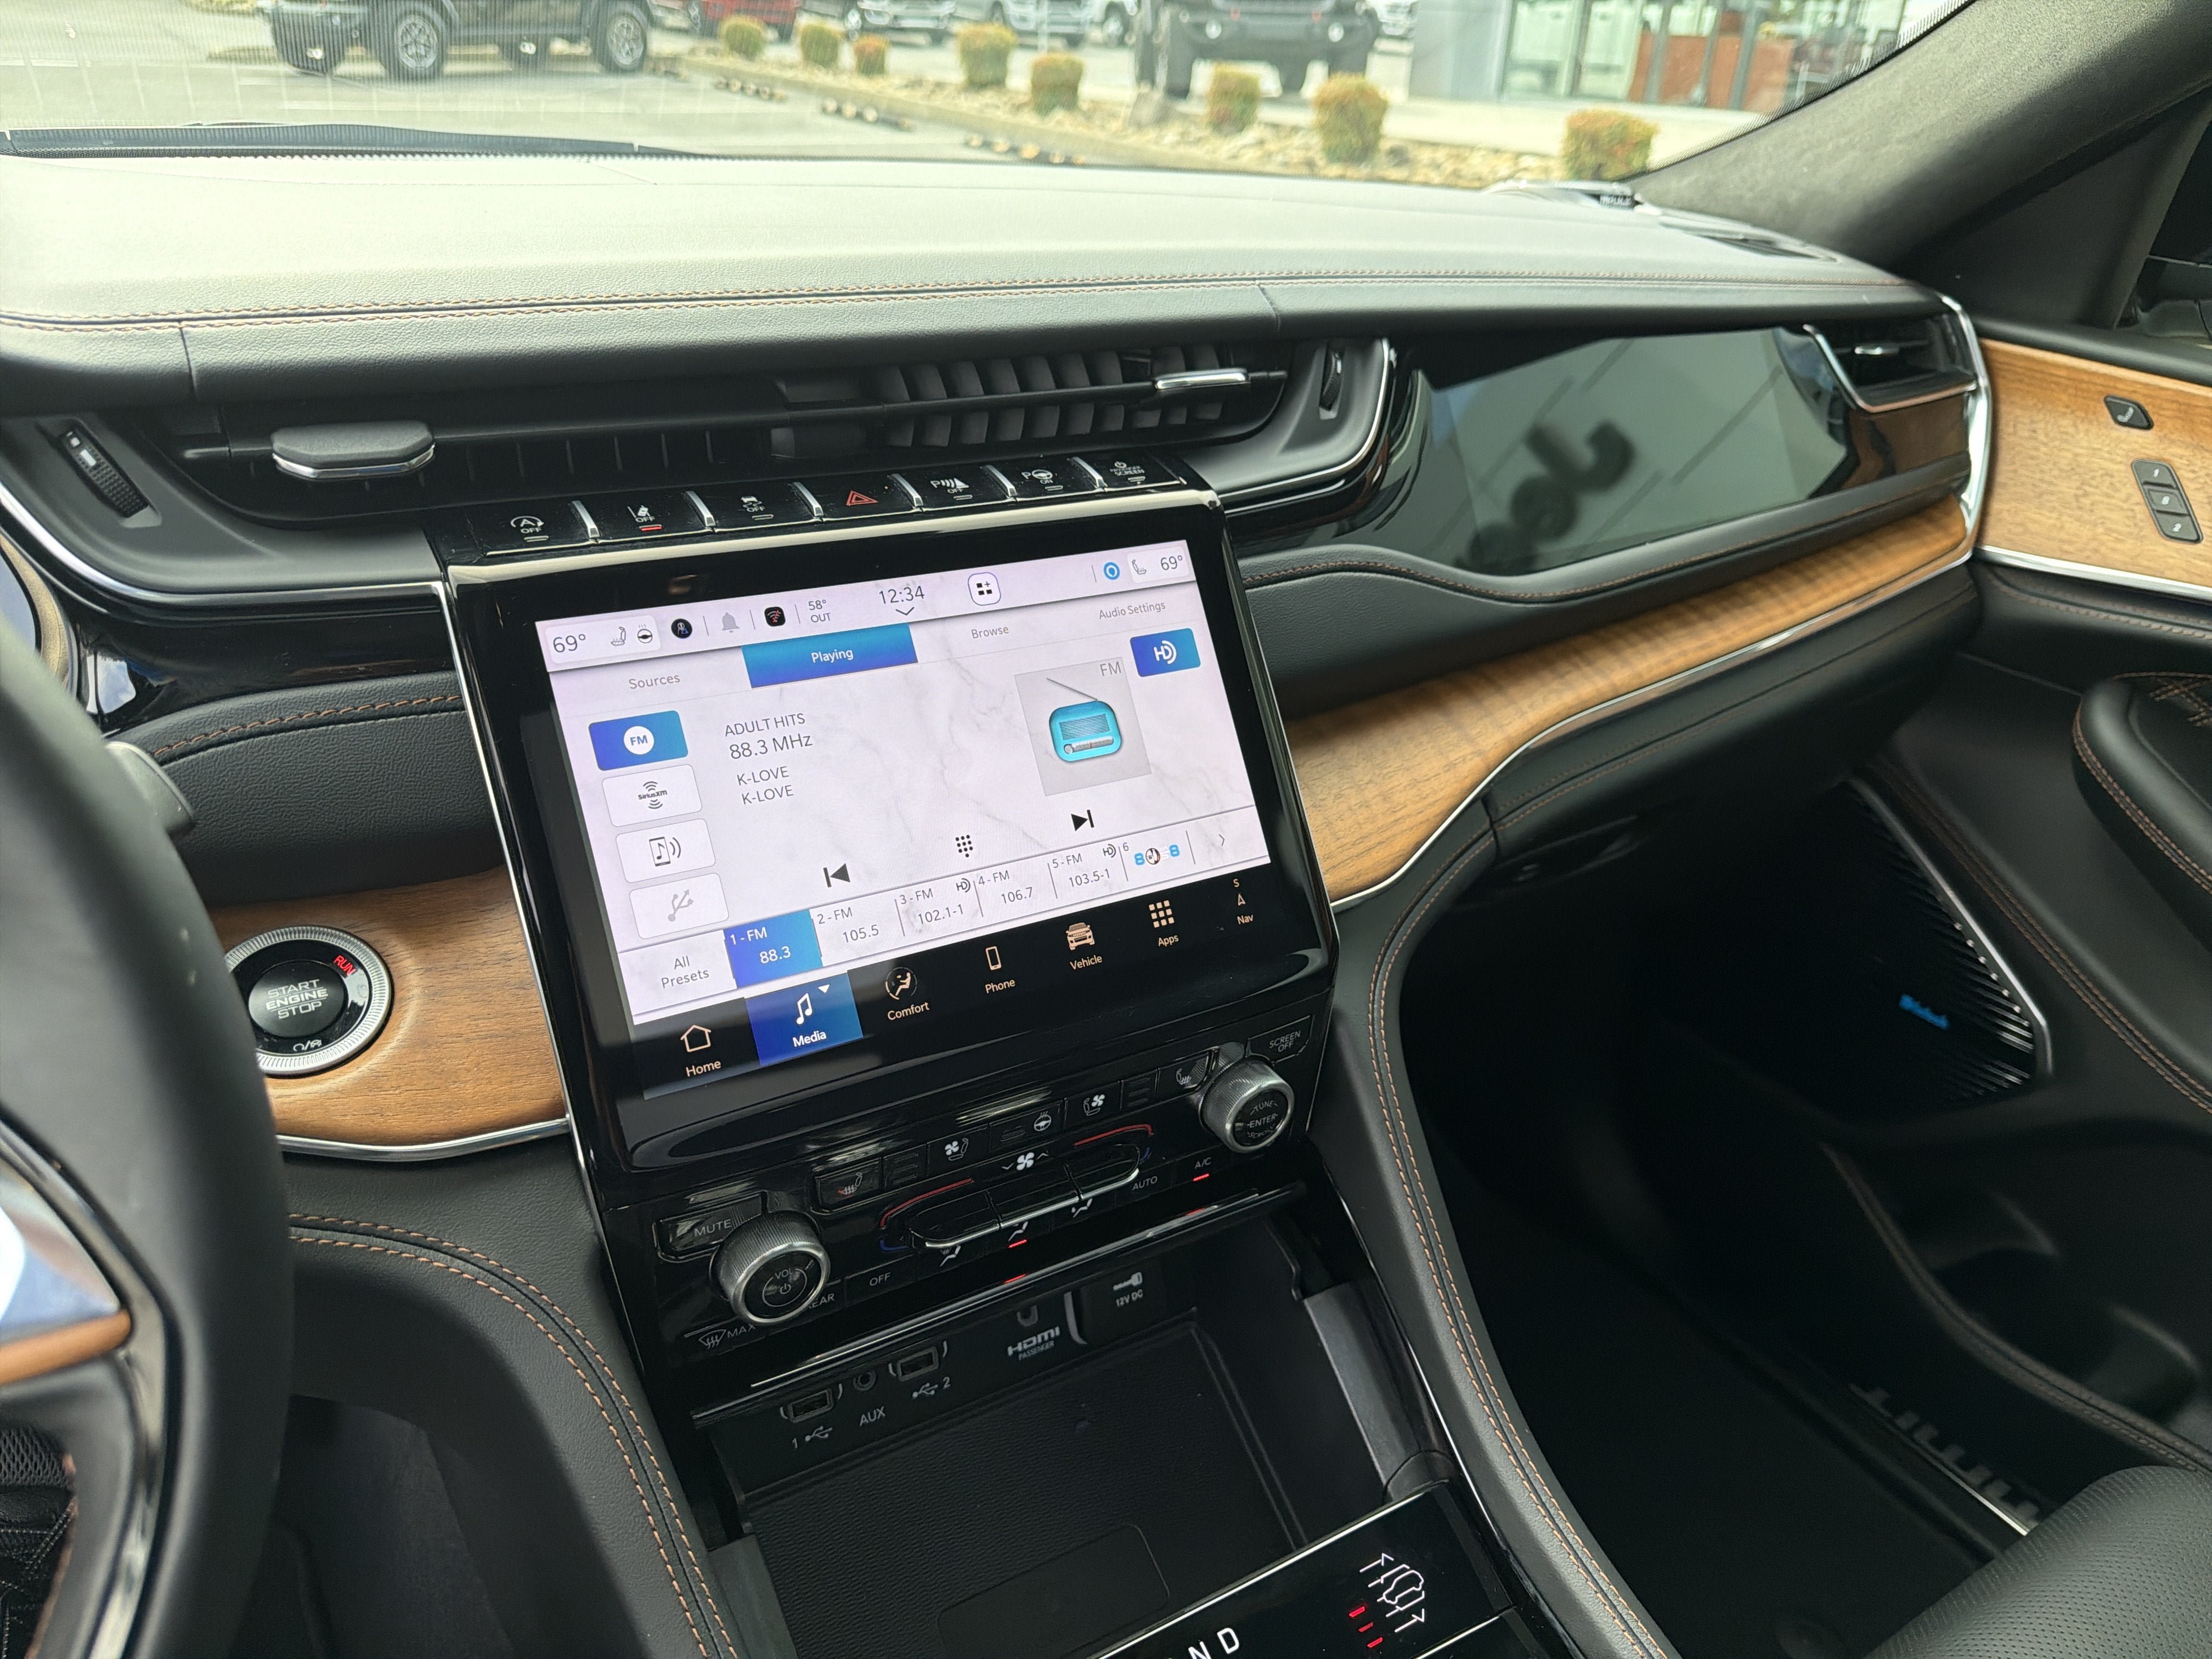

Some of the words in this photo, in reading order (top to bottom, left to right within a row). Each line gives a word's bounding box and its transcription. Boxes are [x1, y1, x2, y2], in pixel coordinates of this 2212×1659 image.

[1160, 554, 1183, 571] 69°
[879, 585, 925, 605] 12:34
[808, 599, 827, 611] 58°
[1099, 606, 1126, 619] Audio
[1127, 601, 1166, 615] Settings
[810, 612, 831, 623] OUT
[971, 625, 1009, 639] Browse
[552, 633, 586, 653] 69°
[811, 648, 854, 663] Playing
[1099, 661, 1121, 676] FM
[628, 674, 680, 690] Sources
[725, 718, 770, 737] ADULT
[775, 713, 805, 728] HITS
[630, 735, 648, 746] FM
[729, 739, 768, 759] 88.3
[772, 732, 813, 752] MHz
[737, 766, 789, 786] K-LOVE
[741, 785, 794, 805] K-LOVE
[1122, 842, 1129, 851] 6
[1052, 858, 1059, 868] 5
[1066, 853, 1082, 866] FM
[978, 875, 986, 886] 4
[992, 870, 1010, 883] FM
[1069, 868, 1111, 888] 103.5-1
[1233, 879, 1240, 887] S
[900, 894, 907, 905] 3
[915, 888, 933, 901] FM
[1001, 887, 1033, 904] 106.7
[817, 913, 825, 925] 2
[833, 907, 853, 920] FM
[917, 904, 964, 925] 102.1-1
[1236, 913, 1254, 924] Nav
[730, 934, 737, 945] 1
[747, 927, 768, 942] FM
[843, 924, 879, 943] 105.5
[1158, 934, 1179, 947] Apps
[674, 956, 690, 969] All
[759, 946, 791, 964] 88.3
[1070, 954, 1102, 970] Vehicle
[333, 955, 357, 976] RUN
[661, 969, 710, 989] Presets
[985, 978, 1015, 994] Phone
[268, 979, 320, 998] START
[266, 988, 329, 1011] ENGINE
[278, 1000, 322, 1019] STOP
[887, 1001, 930, 1020] Comfort
[792, 1030, 827, 1047] Media
[1268, 1030, 1301, 1048] SCREEN
[1278, 1041, 1294, 1053] OFF
[686, 1059, 721, 1077] Home
[1194, 1157, 1211, 1169] A/C
[1132, 1176, 1158, 1190] AUTO
[693, 1219, 731, 1238] MUTE
[775, 1268, 794, 1280] VOL
[869, 1272, 891, 1286] OFF
[809, 1293, 834, 1309] EAR
[1115, 1293, 1130, 1308] 12V
[727, 1323, 757, 1339] MAX
[1007, 1325, 1060, 1357] HDMI
[943, 1376, 951, 1389] 2
[860, 1406, 886, 1426] AUX
[792, 1437, 798, 1450] 1
[1188, 1641, 1211, 1659] N
[1217, 1627, 1239, 1654] D
